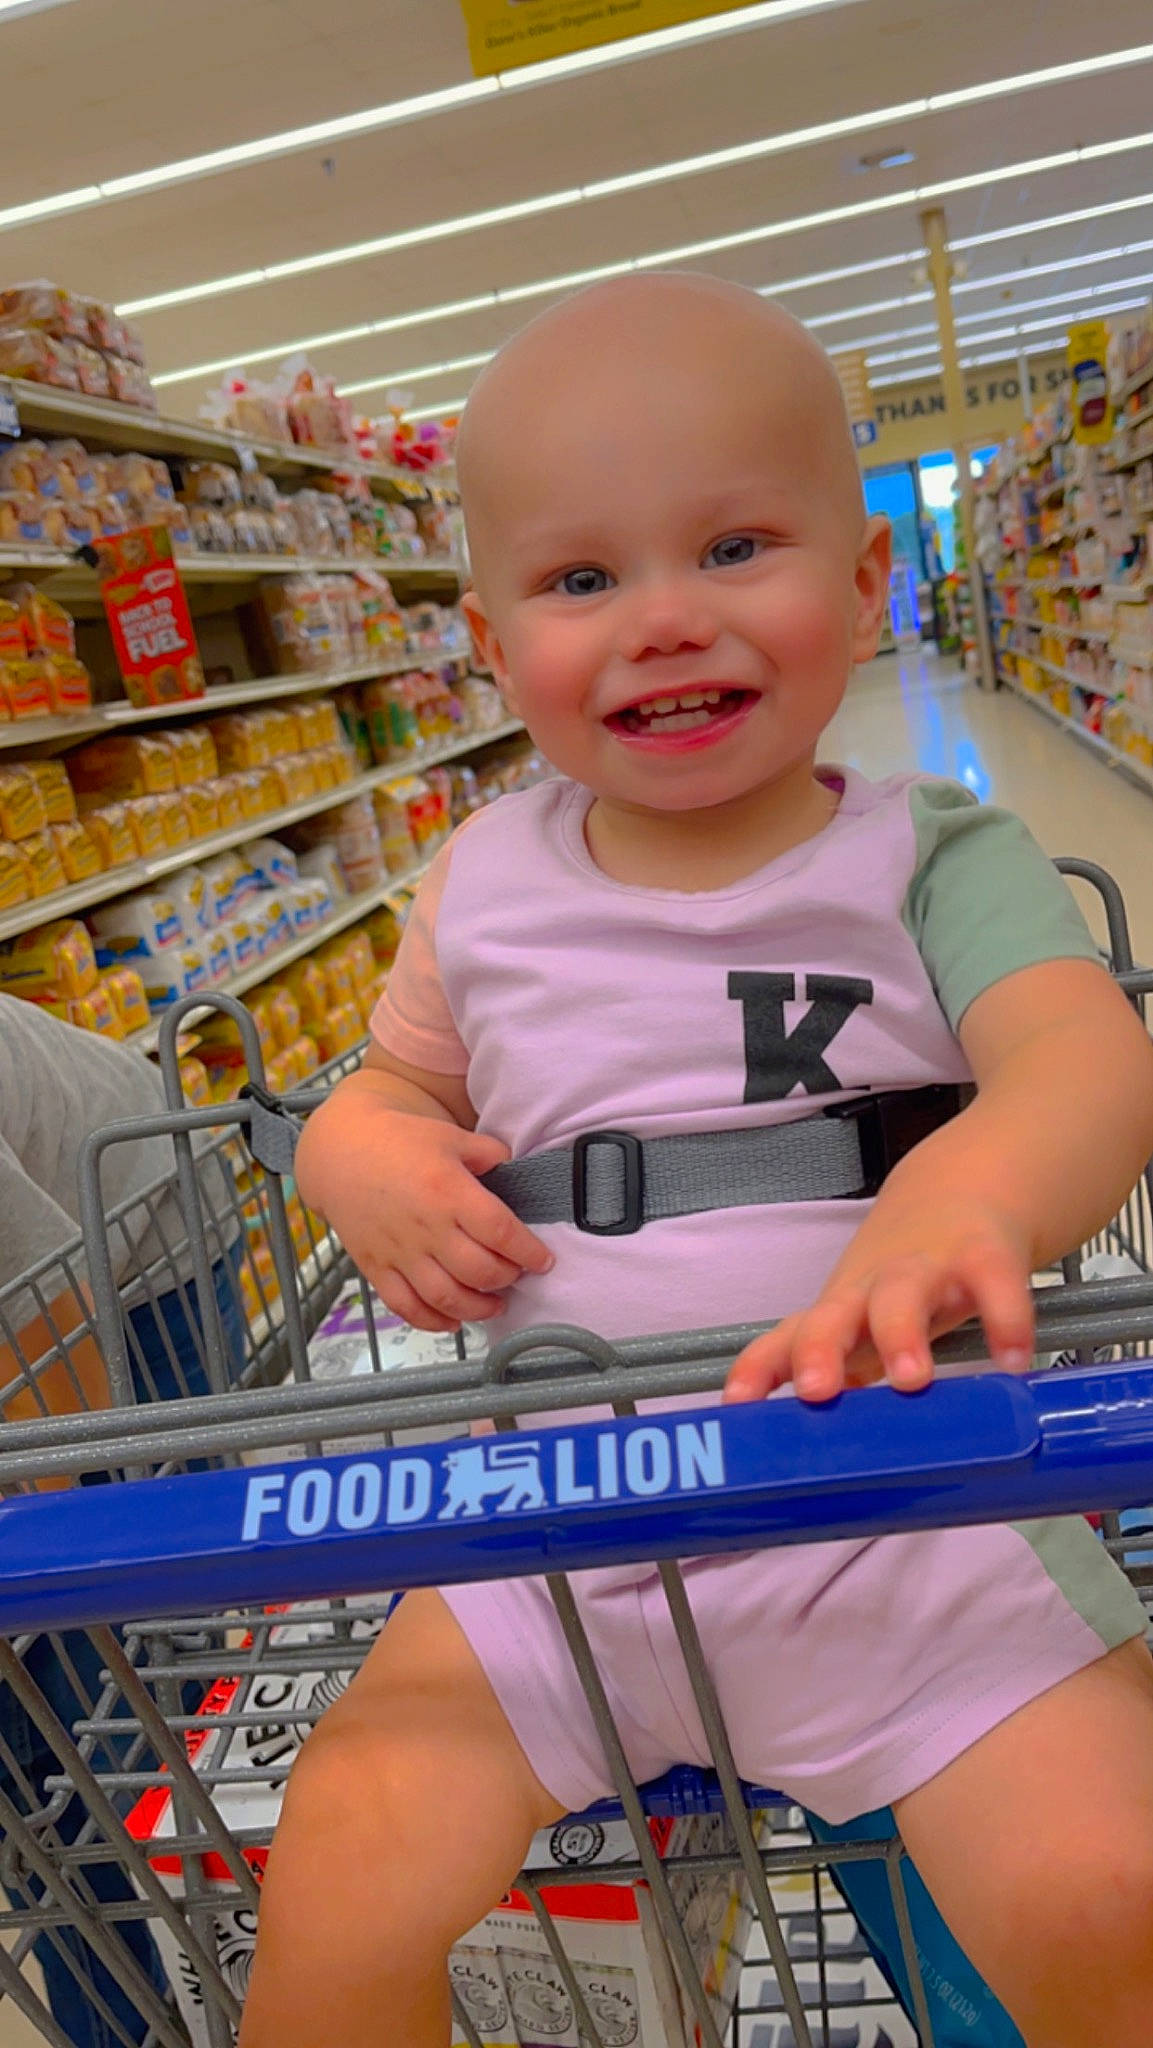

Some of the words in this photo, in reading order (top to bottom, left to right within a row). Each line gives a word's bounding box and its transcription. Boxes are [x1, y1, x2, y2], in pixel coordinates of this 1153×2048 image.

[875, 384, 980, 425] THANS
[127, 627, 188, 664] FUEL
[727, 970, 874, 1104] K
[241, 1457, 432, 1541] FOOD
[555, 1420, 726, 1504] LION
[452, 1965, 498, 1991] CLAW
[524, 1968, 567, 1997] CLAW
[588, 1982, 633, 2007] CLAW
